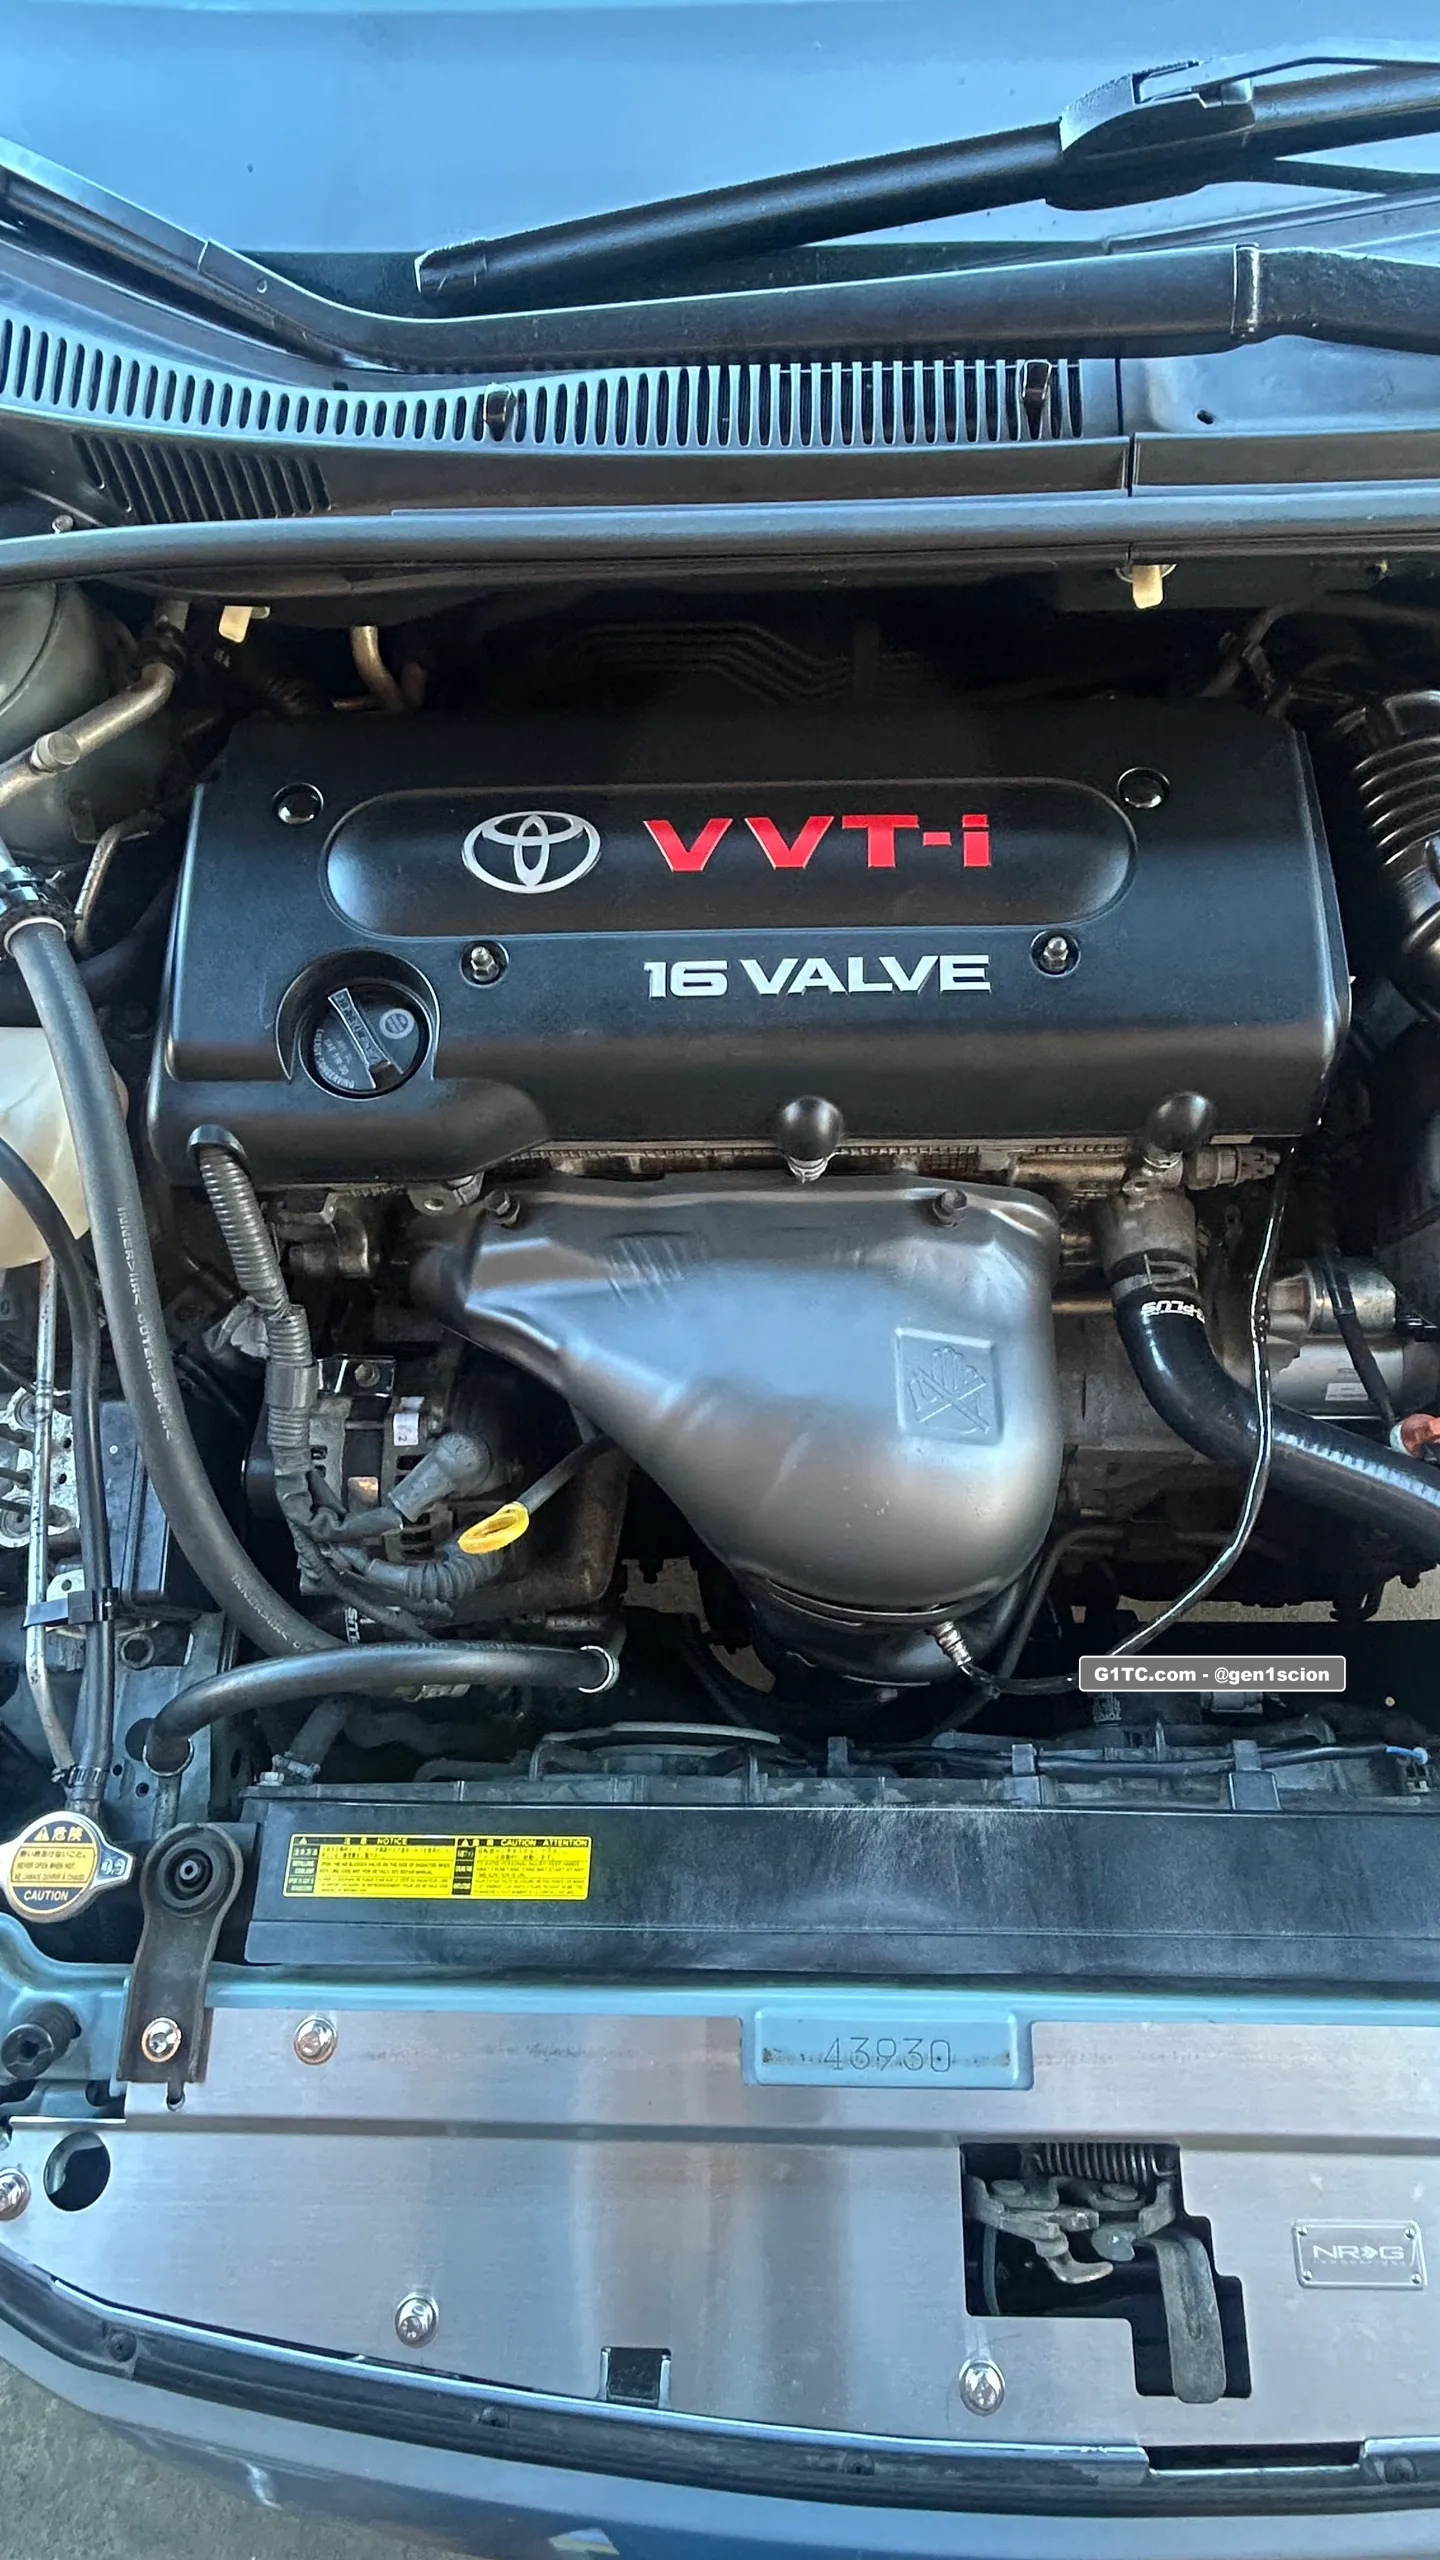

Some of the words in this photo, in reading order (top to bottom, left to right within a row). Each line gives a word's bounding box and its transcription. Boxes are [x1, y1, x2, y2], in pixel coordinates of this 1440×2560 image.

[643, 814, 992, 872] VVT-i
[643, 959, 728, 999] 16
[740, 955, 992, 997] VALVE
[51, 1826, 84, 1842] 危険
[500, 1839, 537, 1847] CAUTION
[542, 1839, 588, 1847] ATTENTION
[23, 1889, 69, 1901] CAUTION
[824, 2036, 951, 2073] 43930
